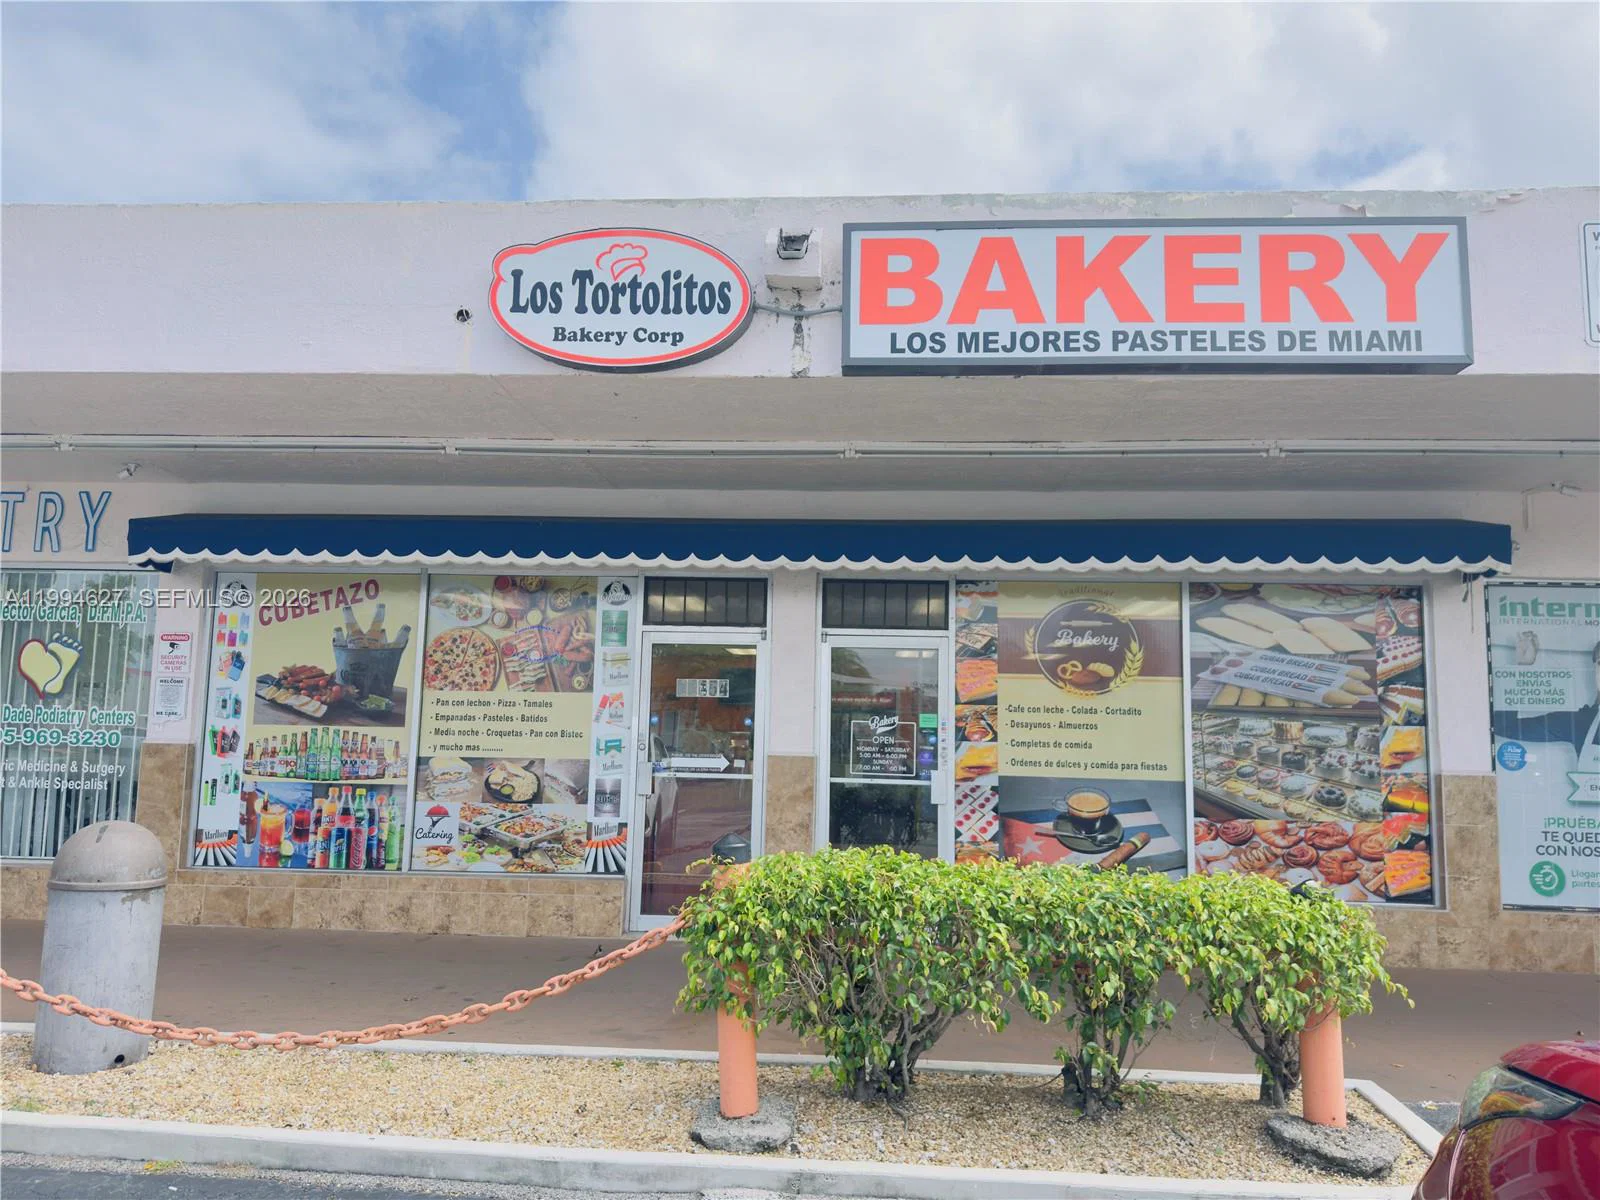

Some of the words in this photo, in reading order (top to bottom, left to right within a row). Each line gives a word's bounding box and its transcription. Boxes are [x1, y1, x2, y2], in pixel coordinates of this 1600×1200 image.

[858, 232, 1451, 325] BAKERY
[510, 269, 563, 314] Los
[572, 269, 731, 315] Tortolitos
[552, 326, 628, 346] Bakery
[633, 327, 684, 346] Corp
[890, 331, 947, 354] LOS
[957, 330, 1101, 353] MEJORES
[1112, 330, 1267, 352] PASTELES
[1277, 330, 1318, 352] DE
[1328, 330, 1422, 352] MIAMI
[0, 491, 112, 552] TRY
[258, 579, 379, 626] CUBETAZO
[0, 602, 33, 621] ector
[1056, 628, 1120, 652] Bakery
[1260, 654, 1286, 664] CUBAN
[1286, 658, 1315, 669] BREAD
[1234, 671, 1262, 681] CUBAN
[1261, 676, 1292, 687] BREAD
[1250, 665, 1277, 675] CUBAN
[1277, 670, 1308, 680] BREAD
[1494, 670, 1516, 679] CON
[1518, 670, 1572, 679] NOSOTROS
[1504, 688, 1541, 696] MUCHO
[436, 698, 449, 707] Pan
[467, 699, 491, 707] lechon
[497, 699, 516, 707] Pizza
[523, 699, 553, 708] Tamales
[1504, 697, 1526, 706] QUE
[1527, 697, 1565, 705] DINERO
[2, 704, 33, 723] Dade
[34, 704, 85, 728] Podiatry
[88, 706, 137, 726] Centers
[435, 713, 476, 723] Empanadas
[483, 713, 514, 722] Pasteles
[520, 714, 548, 723] Batidos
[1043, 705, 1065, 714] leche
[1071, 706, 1098, 715] Colada
[1105, 706, 1142, 716] Cortadito
[868, 714, 899, 729] Bakery
[1010, 720, 1051, 731] Desayunos
[1058, 720, 1098, 730] Almuerzos
[0, 727, 121, 748] 5-969-3230
[434, 727, 455, 736] Media
[457, 728, 479, 737] noche
[486, 728, 523, 739] Croquetas
[529, 729, 543, 737] Pan
[872, 736, 895, 745] OPEN
[433, 744, 438, 752] y
[440, 743, 464, 751] mucho
[1010, 739, 1051, 749] Completas
[1053, 740, 1063, 748] de
[1064, 740, 1093, 749] comida
[19, 760, 66, 772] Medicine
[70, 760, 78, 773] &
[82, 760, 126, 777] Surgery
[1010, 758, 1042, 768] Ordenes
[1044, 759, 1054, 768] de
[1056, 760, 1082, 769] dulces
[1083, 762, 1088, 771] y
[1090, 761, 1119, 770] comida
[1121, 763, 1139, 772] para
[1140, 762, 1168, 771] fiestas
[8, 776, 16, 788] &
[19, 776, 50, 789] Ankle
[53, 776, 108, 791] Specialist
[415, 827, 454, 844] Catering
[1541, 830, 1559, 842] TE
[1536, 844, 1567, 856] CON
[1571, 845, 1600, 857] NOS
